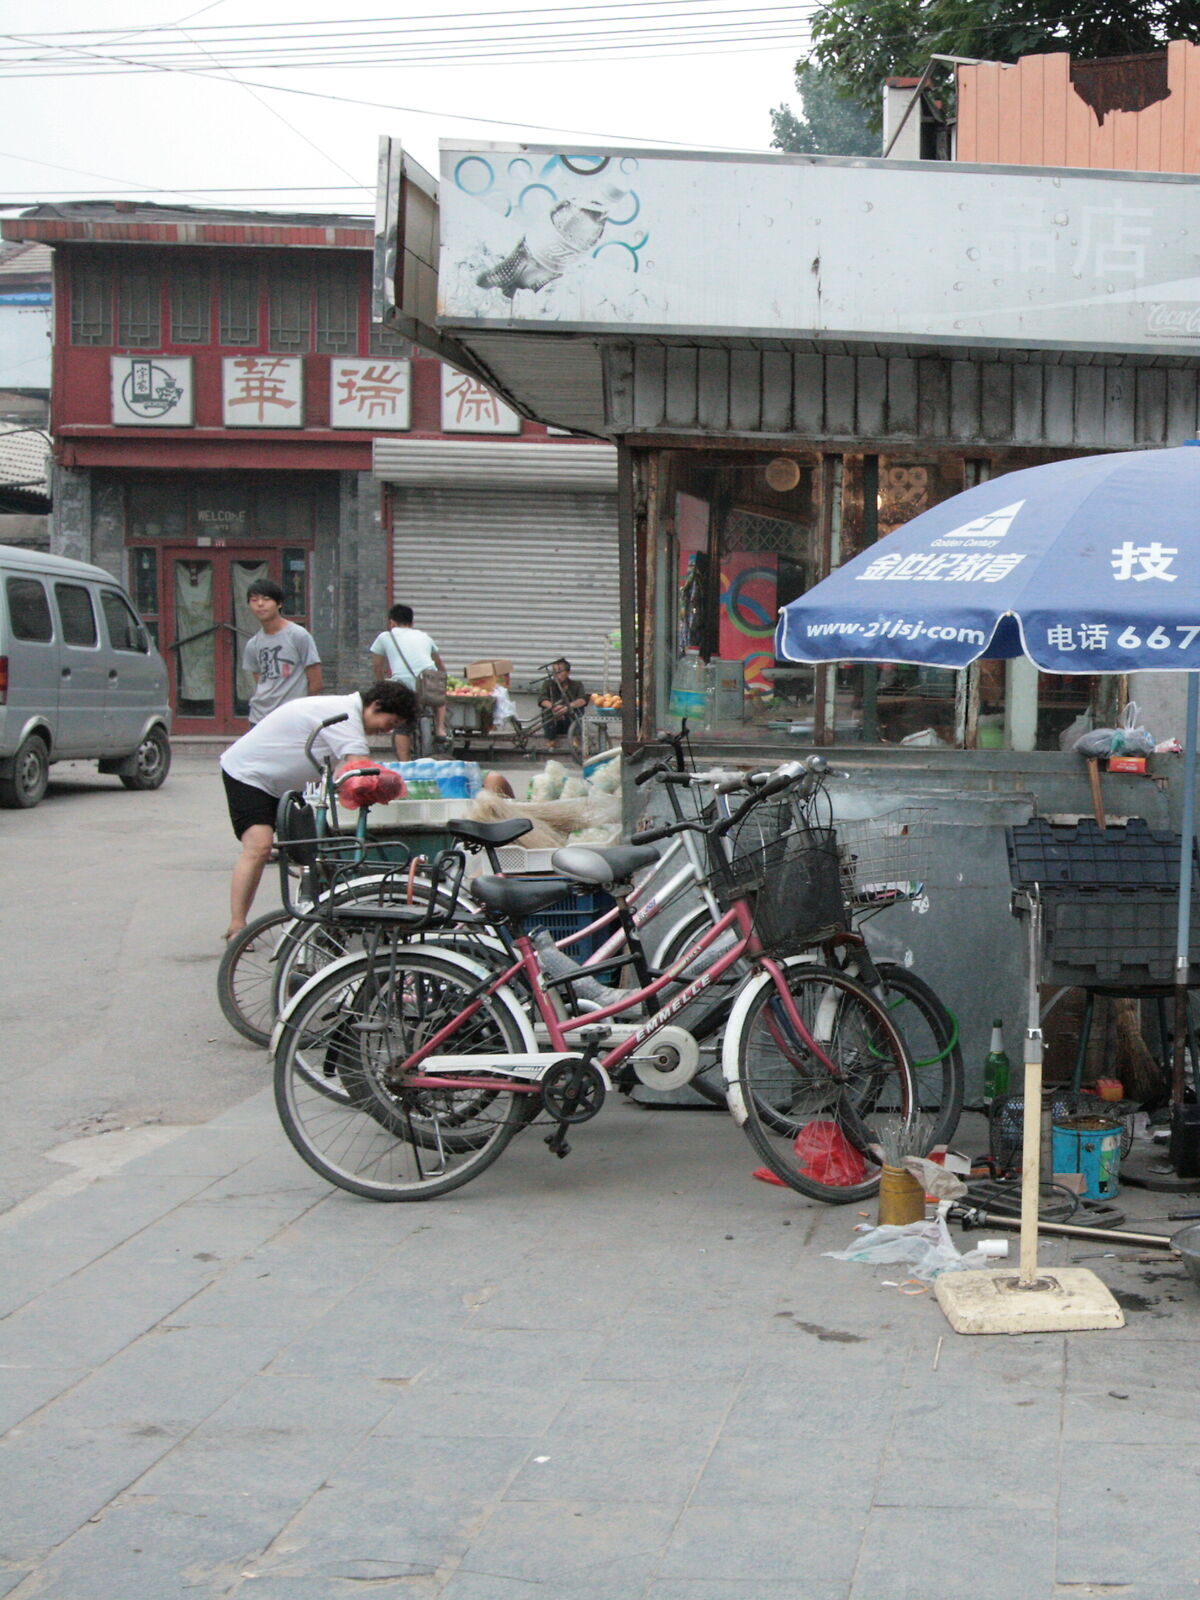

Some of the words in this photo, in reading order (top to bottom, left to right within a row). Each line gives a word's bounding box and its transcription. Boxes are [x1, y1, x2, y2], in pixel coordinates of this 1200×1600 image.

[854, 551, 1028, 583] 金世纪教育
[1046, 623, 1110, 651] 电话
[635, 973, 714, 1043] EMMELLE
